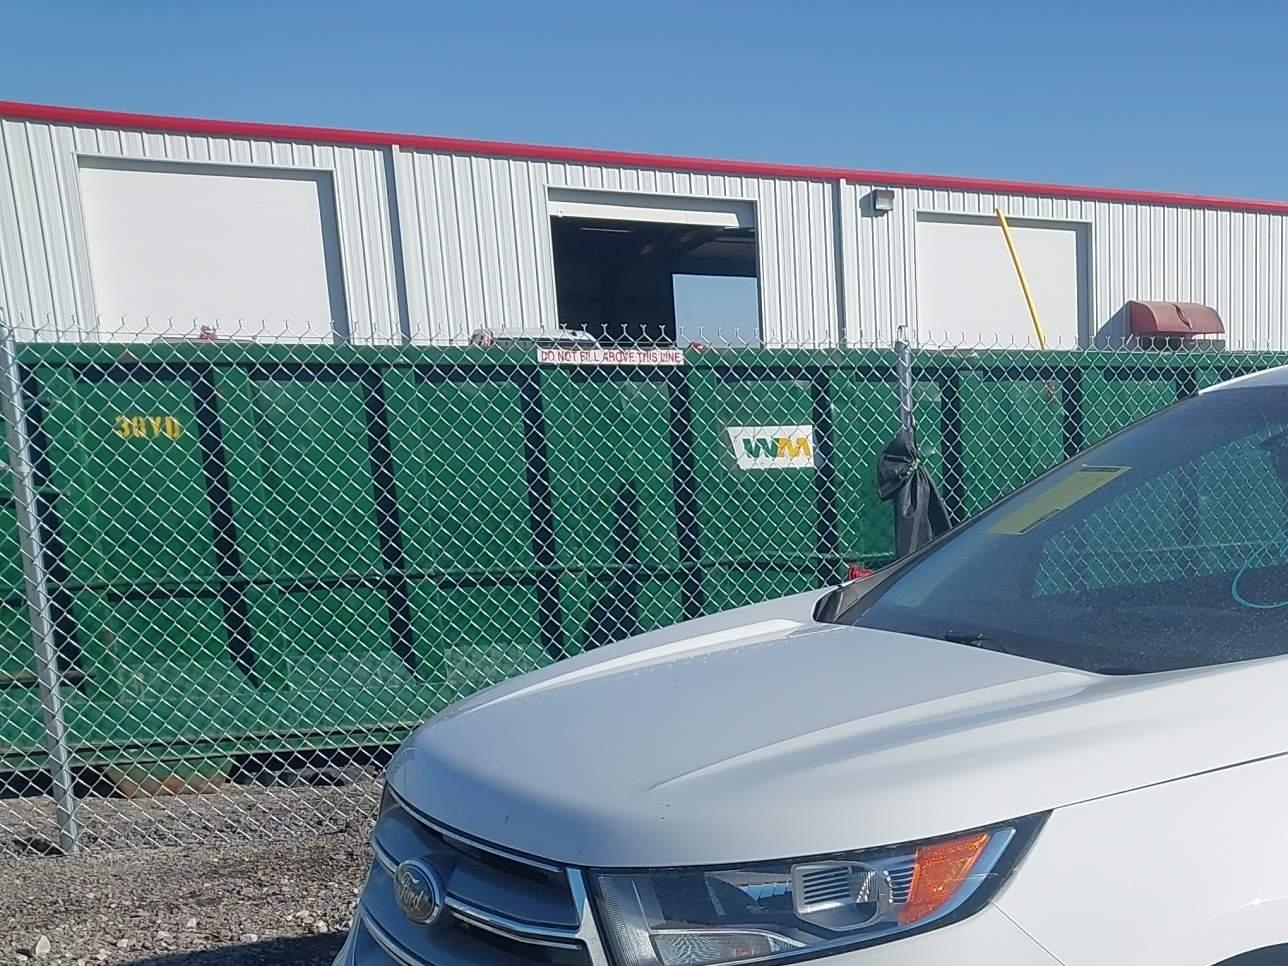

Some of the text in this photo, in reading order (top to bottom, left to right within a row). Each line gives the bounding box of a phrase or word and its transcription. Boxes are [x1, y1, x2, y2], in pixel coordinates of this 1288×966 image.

[541, 351, 555, 361] DO
[557, 351, 577, 361] NOT
[602, 351, 633, 361] ABOVE
[637, 351, 658, 361] THIS
[660, 352, 681, 362] LINE
[743, 438, 812, 458] WM
